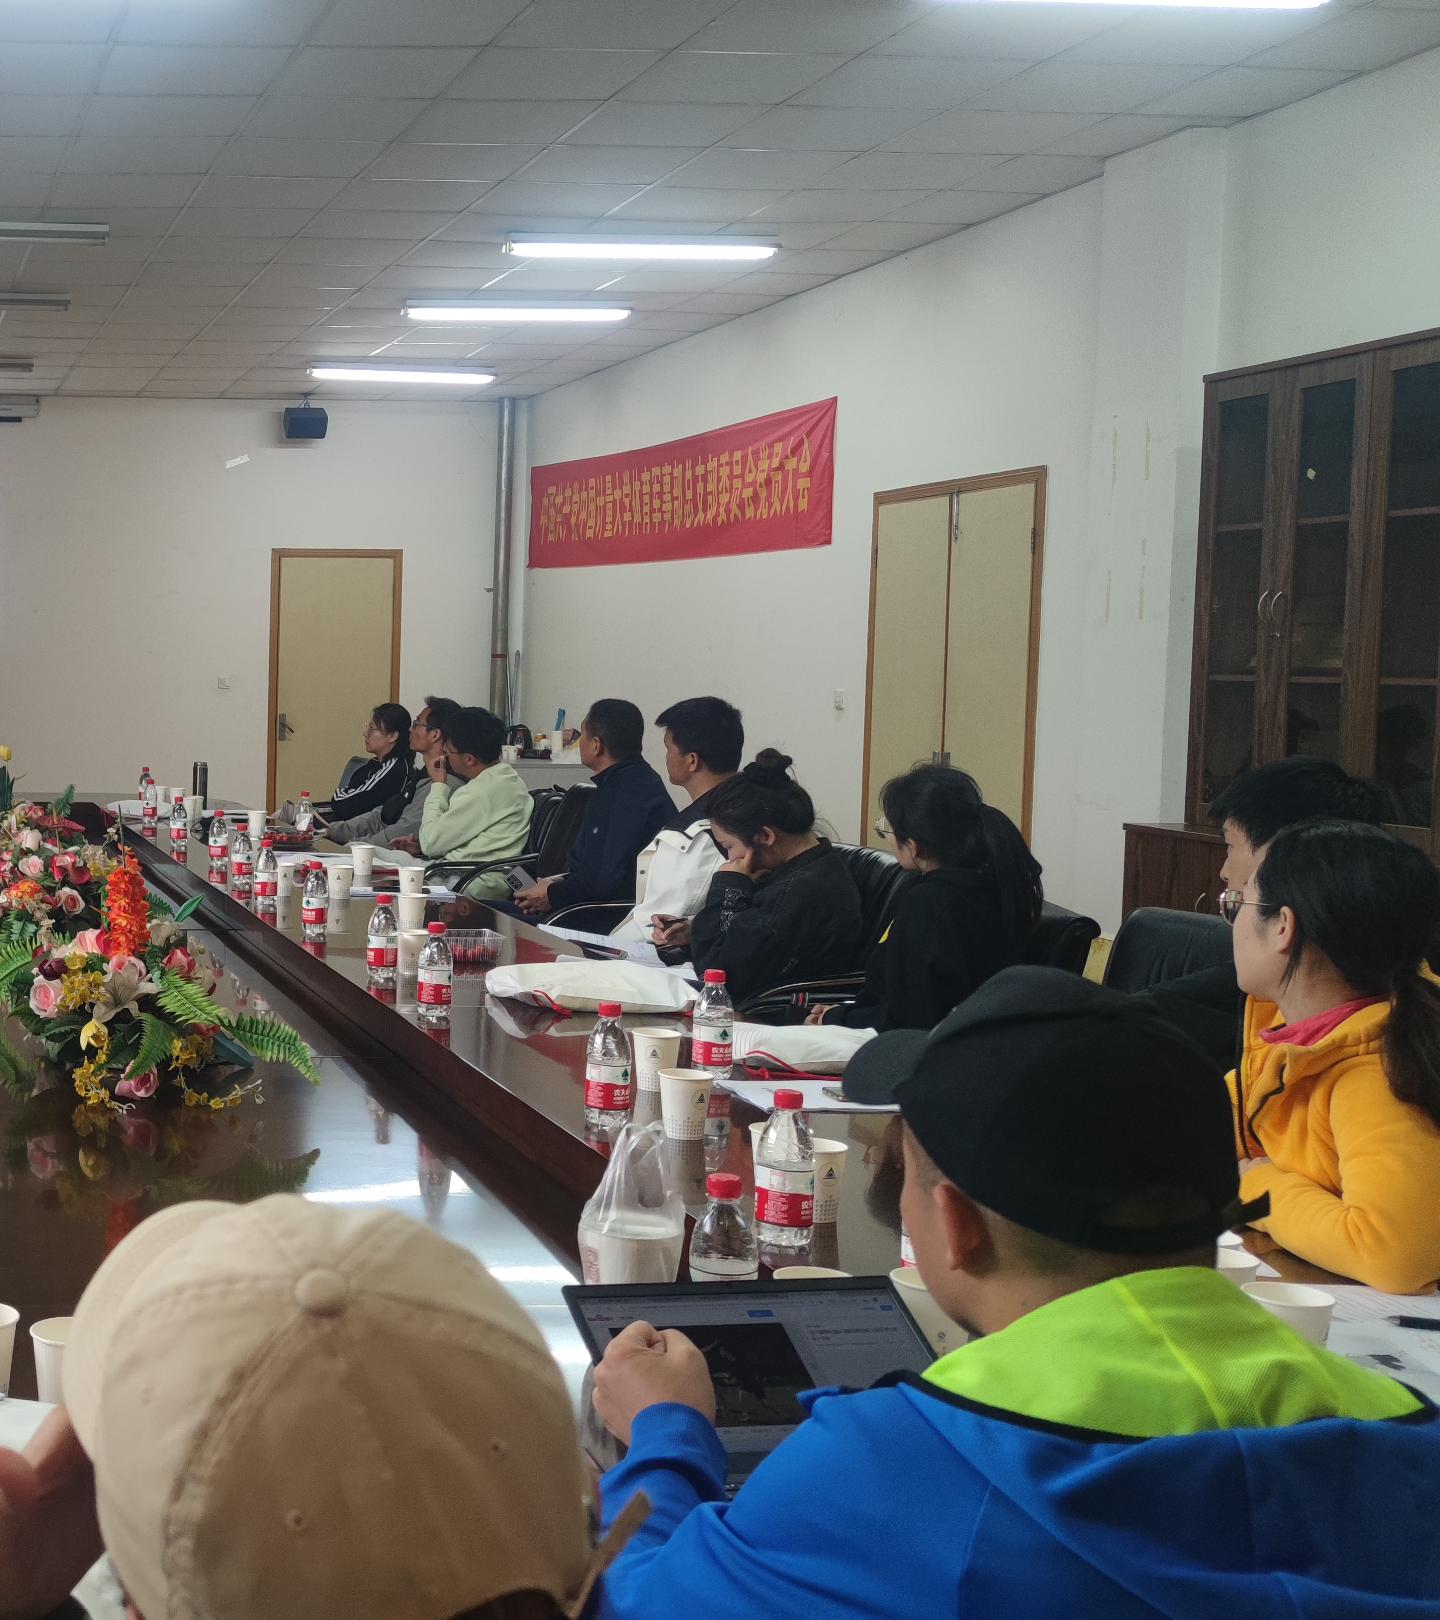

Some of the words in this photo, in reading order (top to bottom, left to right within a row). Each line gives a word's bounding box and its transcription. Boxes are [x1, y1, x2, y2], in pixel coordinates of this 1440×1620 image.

[540, 432, 811, 544] 中国共产党中国计量大学体育军事部总支部委员会党员大会
